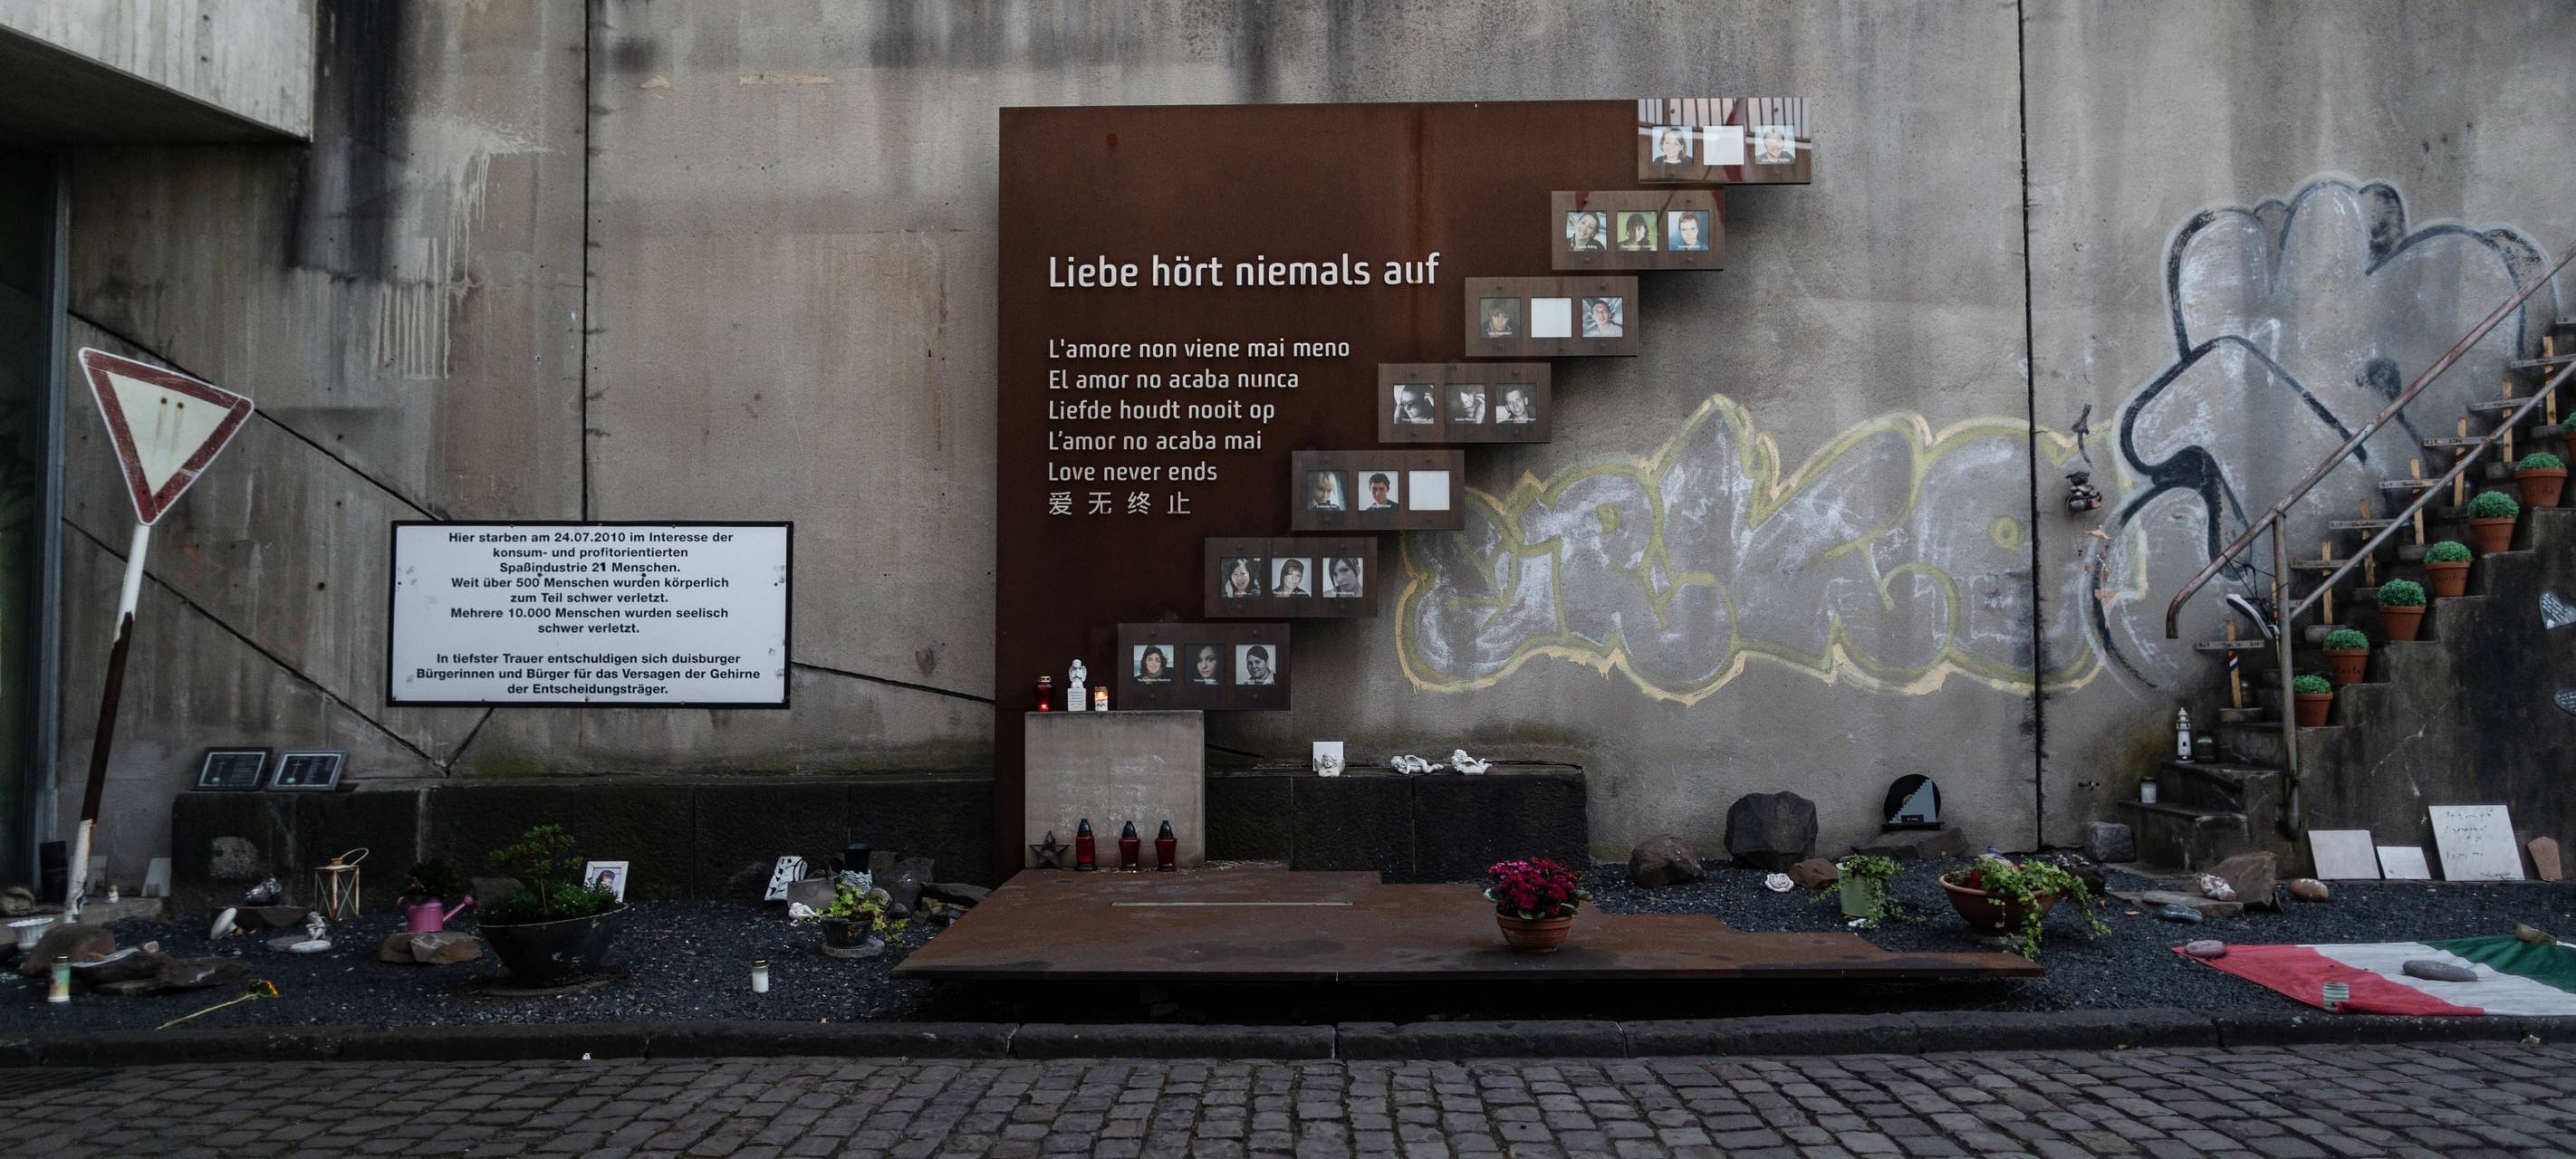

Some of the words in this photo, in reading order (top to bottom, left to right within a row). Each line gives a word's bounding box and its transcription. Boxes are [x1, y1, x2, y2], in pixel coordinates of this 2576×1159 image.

[1050, 254, 1139, 288] Liebe
[1152, 254, 1224, 287] hört
[1235, 253, 1370, 286] niemals
[1383, 252, 1441, 285] auf
[1139, 342, 1177, 359] non
[1184, 338, 1240, 358] viene
[1247, 337, 1284, 358] mai
[1293, 341, 1350, 358] meno
[1049, 369, 1069, 389] El
[1075, 374, 1129, 389] amor
[1137, 373, 1161, 388] no
[1168, 368, 1229, 388] acaba
[1237, 373, 1299, 388] nunca
[1049, 399, 1112, 420] Liefde
[1120, 398, 1181, 419] houdt
[1188, 399, 1243, 419] nooit
[1249, 404, 1274, 425] op
[1123, 436, 1148, 451] no
[1156, 429, 1216, 450] acaba
[1225, 430, 1262, 450] mai
[1049, 462, 1095, 481] Love
[1103, 465, 1161, 481] never
[1168, 460, 1217, 481] ends
[448, 532, 476, 542] Hier
[478, 532, 527, 542] starben
[531, 534, 551, 542] am
[554, 532, 626, 542] 24.07.2010
[630, 532, 645, 542] im
[649, 532, 708, 542] Interesse
[712, 532, 734, 542] der
[493, 547, 548, 558] konsum-
[552, 547, 575, 558] und
[579, 547, 688, 560] profitorientierten
[499, 561, 588, 574] Spaßindustrie
[591, 561, 606, 572] 21
[611, 561, 681, 572] Menschen.
[451, 577, 479, 588] Weit
[483, 577, 513, 588] über
[515, 577, 540, 588] 500
[543, 577, 610, 588] Menschen
[612, 576, 660, 588] wurden
[664, 577, 729, 589] körperlich
[510, 595, 537, 603] zum
[541, 592, 562, 603] Teil
[566, 592, 613, 603] schwer
[616, 592, 668, 603] verletzt.
[450, 608, 504, 618] Mehrere
[508, 608, 552, 618] 10.000
[555, 608, 620, 618] Menschen
[624, 608, 672, 618] wurden
[676, 608, 728, 618] seelisch
[537, 622, 585, 634] schwer
[588, 622, 639, 634] verletzt.
[437, 653, 448, 664] In
[452, 653, 499, 664] tiefster
[502, 653, 544, 664] Trauer
[547, 653, 638, 666] entschuldigen
[641, 653, 668, 664] sich
[671, 653, 741, 666] duisburger
[416, 667, 495, 681] Bürgerinnen
[498, 668, 523, 679] und
[526, 668, 571, 681] Bürger
[572, 668, 592, 679] für
[595, 668, 619, 679] das
[621, 668, 681, 681] Versagen
[685, 668, 706, 679] der
[709, 668, 761, 679] Gehirne
[507, 683, 529, 694] der
[533, 683, 668, 696] Entscheidungsträger.
